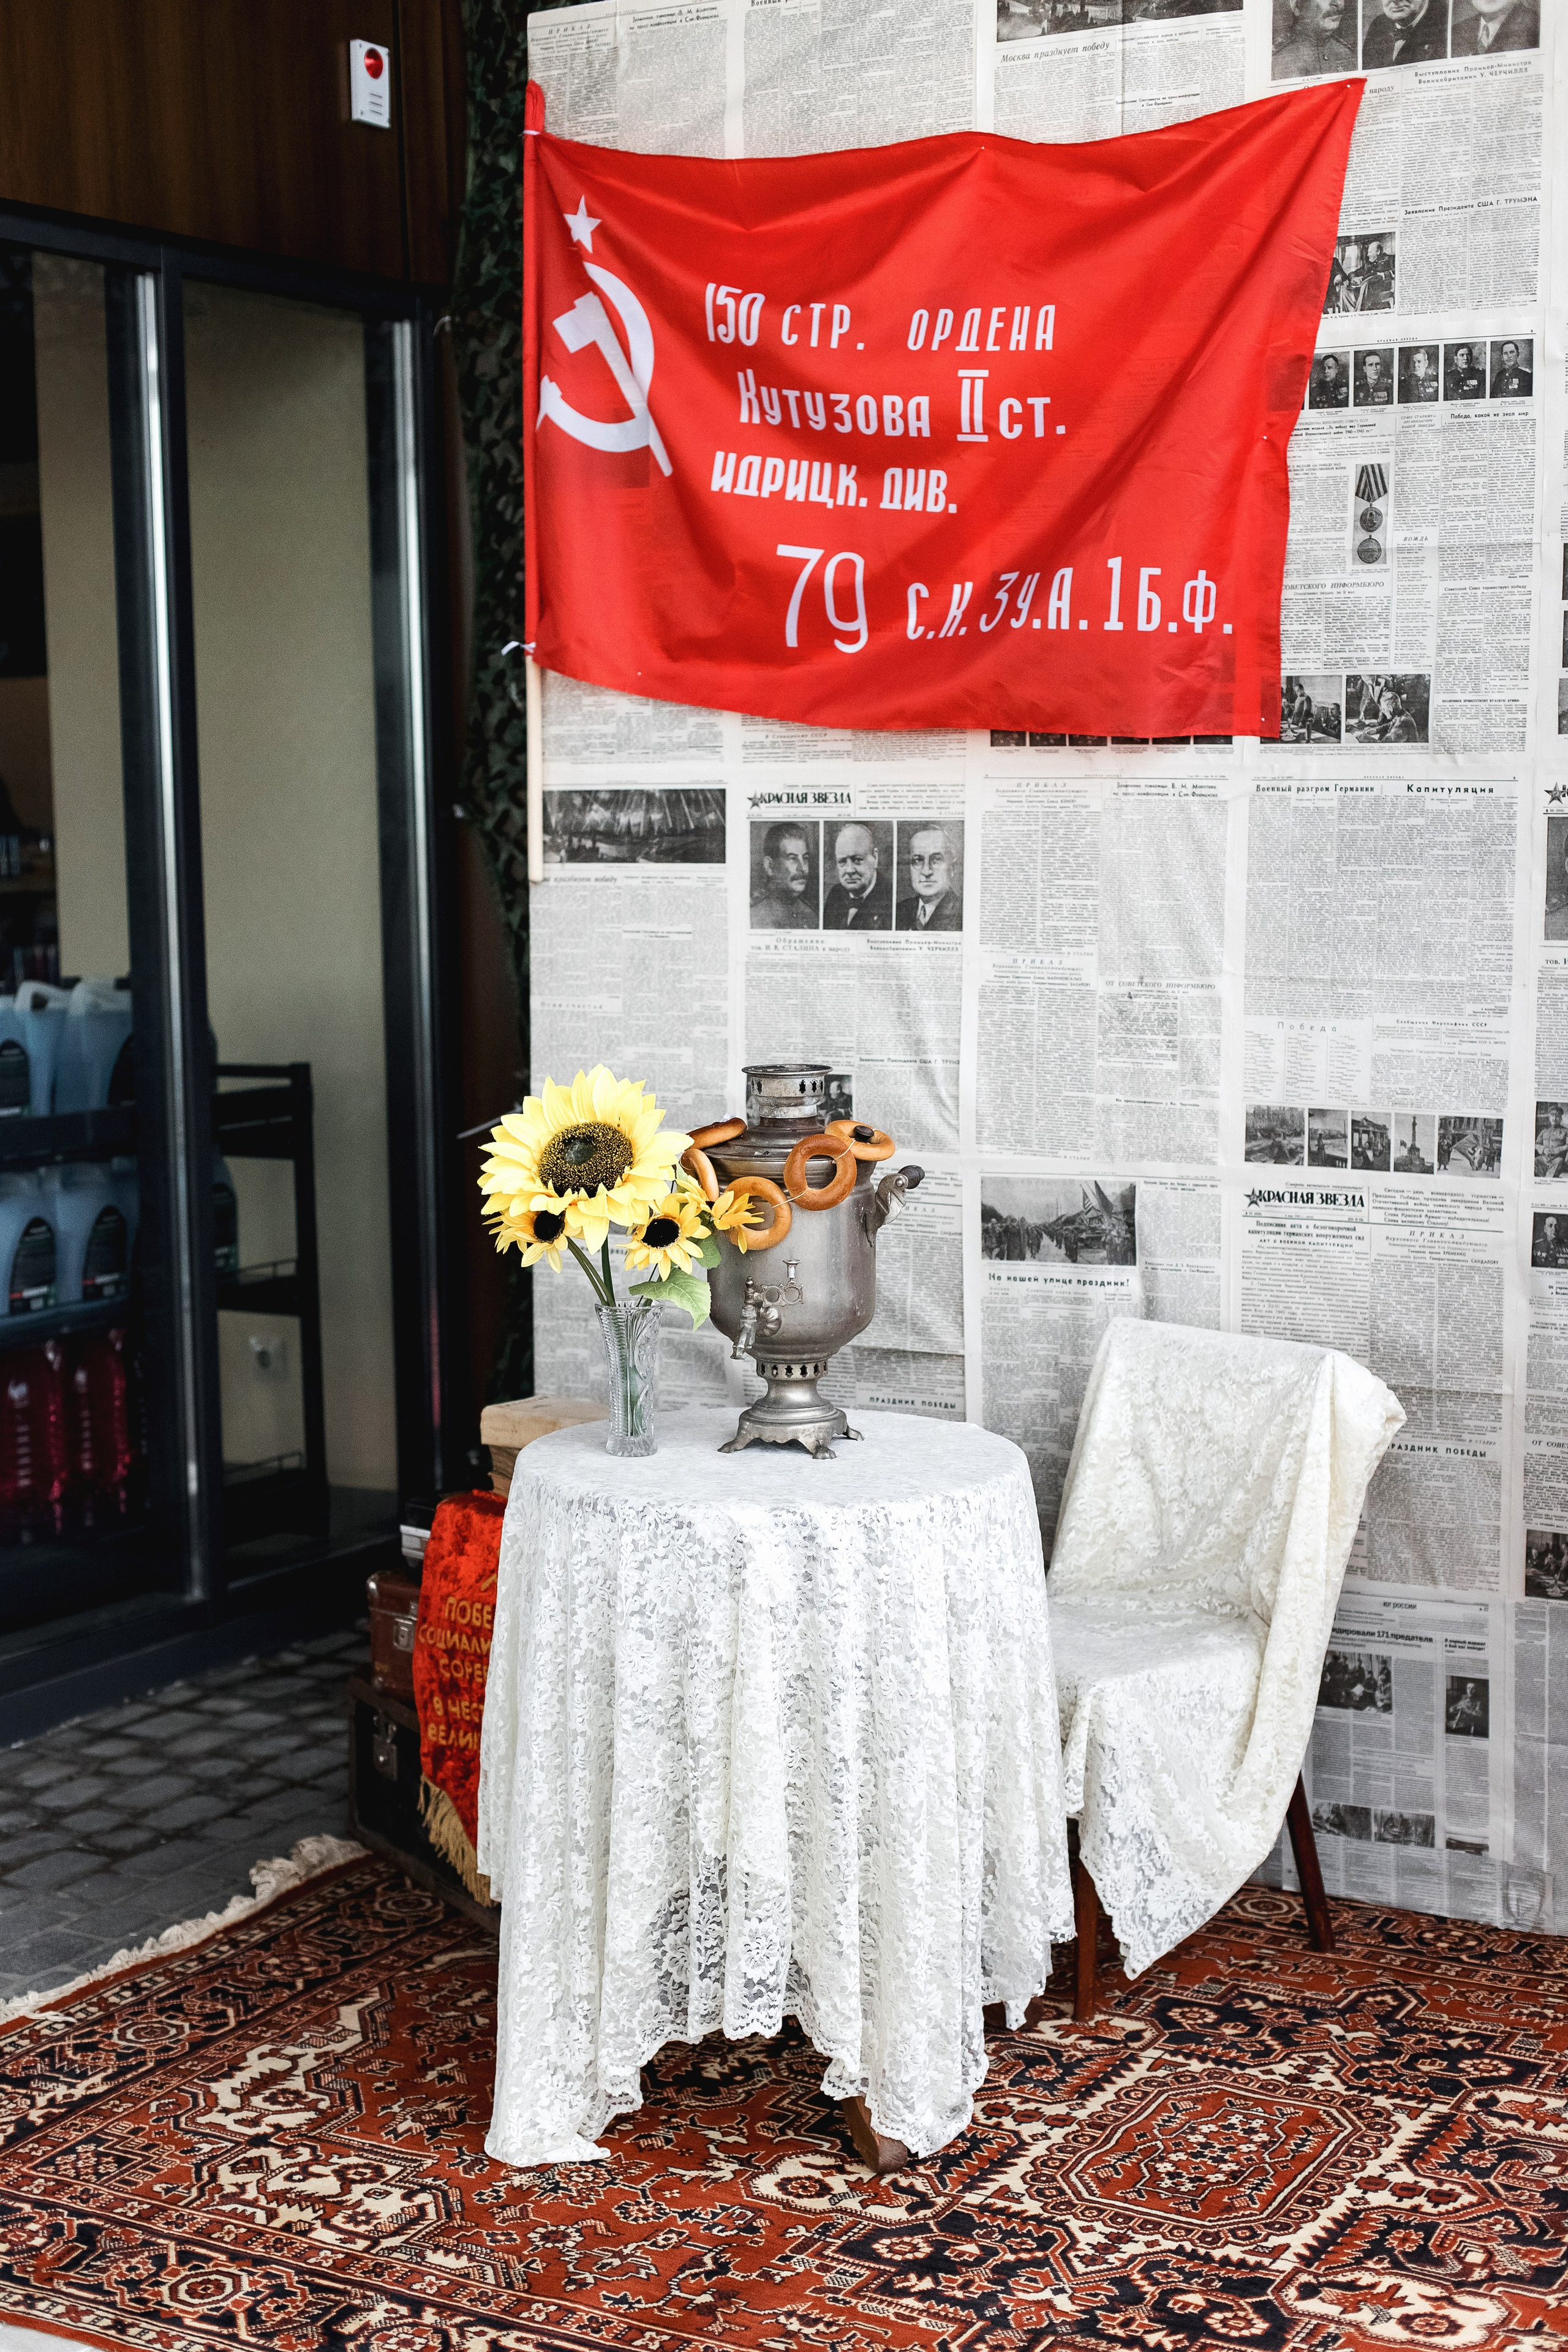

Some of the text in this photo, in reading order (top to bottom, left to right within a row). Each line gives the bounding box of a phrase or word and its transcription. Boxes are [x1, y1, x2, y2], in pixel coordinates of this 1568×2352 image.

[1000, 40, 1110, 63] Москва празднует победу
[1415, 67, 1460, 78] Выступление
[1418, 74, 1477, 85] Великобритании
[1490, 67, 1529, 78] ЧЕРЧИЛЛЯ
[1368, 85, 1395, 95] народу
[1439, 203, 1475, 212] Президента
[1504, 195, 1538, 204] ТРУМЭНА
[706, 283, 1055, 351] 150 СТР. ОРДЕНА
[1330, 581, 1384, 589] ИНФОРМБЮРО
[777, 545, 868, 653] 79
[1256, 783, 1374, 795] Военный разгром Германии
[1406, 783, 1494, 795] Капитуляция
[761, 792, 809, 805] КРАСНАЯ
[809, 791, 852, 804] ЗВЕЗДА
[1278, 1020, 1337, 1033] Победа
[1259, 1189, 1365, 1208] КРАСНАЯ ЗВЕЗДА
[1409, 1230, 1466, 1240] ПРИКАЗ
[989, 1272, 1131, 1288] На нашей улице праздник!
[870, 1396, 956, 1409] ПРАЗДНИК ПОБЕДЫ
[1388, 1444, 1487, 1458] РАЗДНИК ПОБЕДЫ
[1392, 1601, 1417, 1610] россии
[444, 1596, 493, 1630] ПОБЕ
[1390, 1632, 1434, 1644] предателя
[432, 1695, 444, 1716] В
